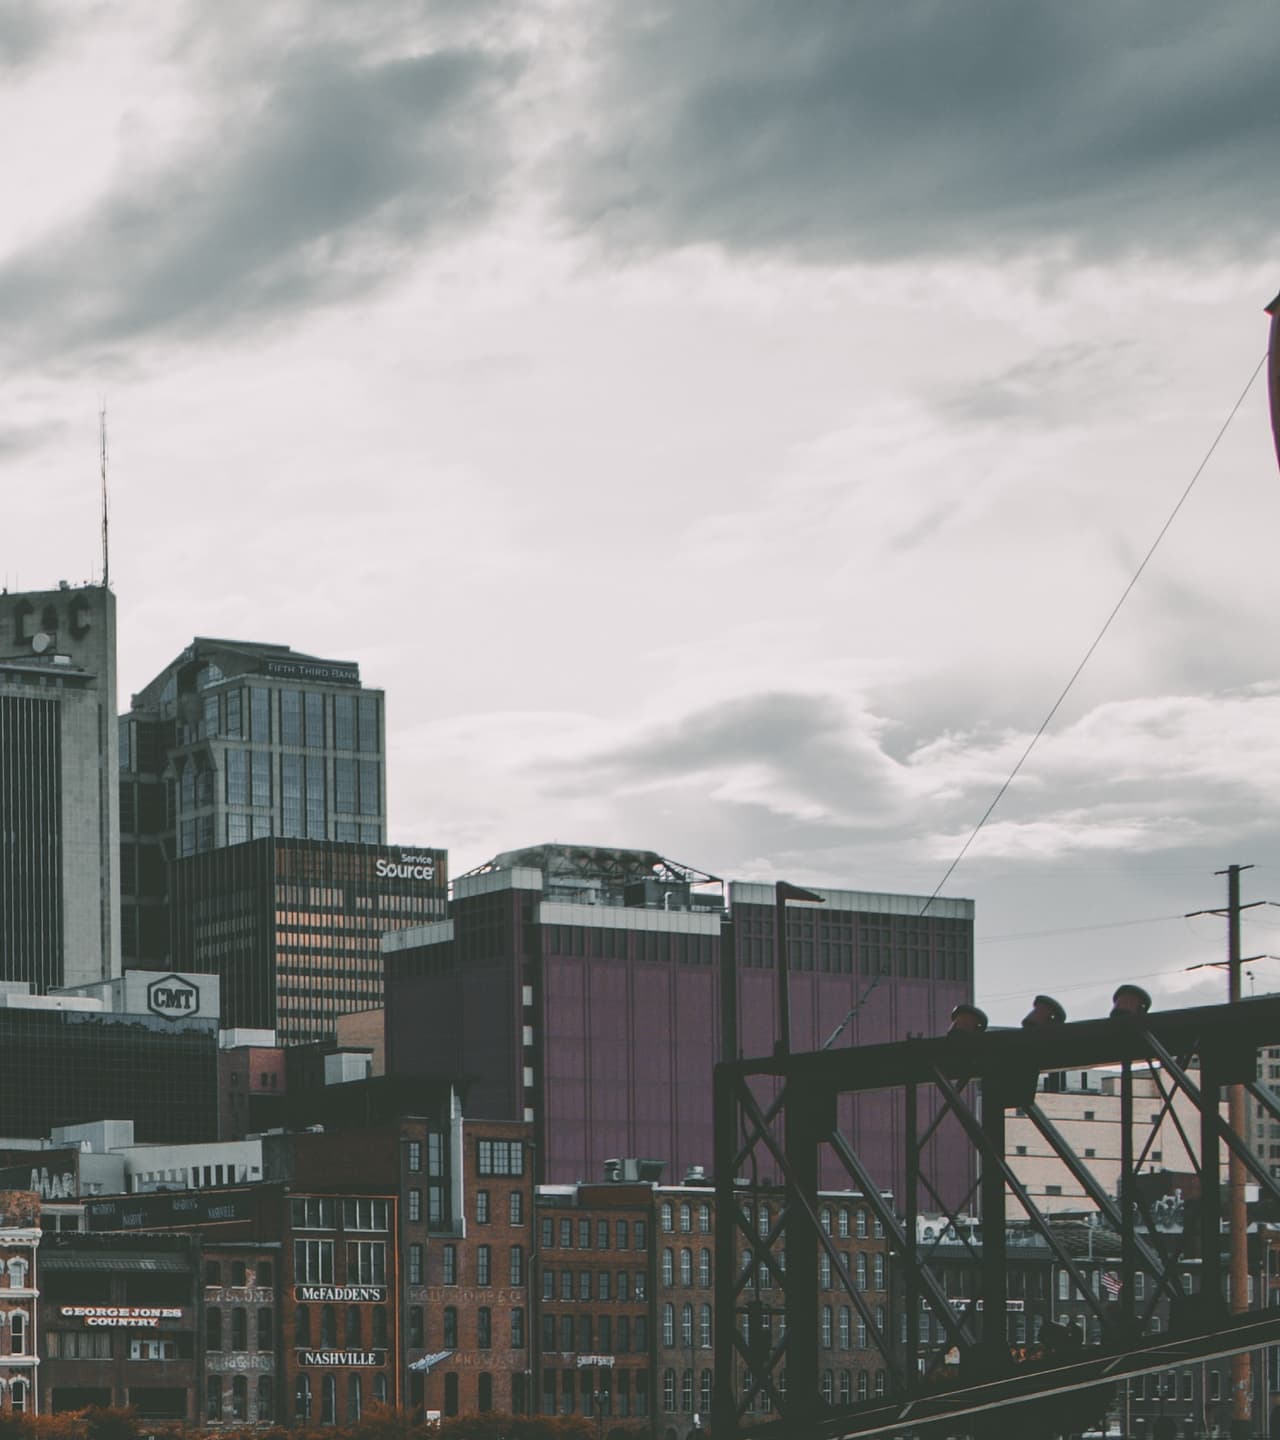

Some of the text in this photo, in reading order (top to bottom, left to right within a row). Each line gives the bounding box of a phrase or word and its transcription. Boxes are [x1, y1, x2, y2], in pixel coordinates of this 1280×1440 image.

[268, 662, 358, 680] FIFTH THIRD BANK
[400, 853, 432, 864] Service
[376, 859, 433, 881] Source
[153, 989, 193, 1010] CMT
[302, 1287, 381, 1301] McFADDEN'S
[60, 1306, 182, 1319] GEORGE JONES
[86, 1317, 160, 1327] COUNTRY
[304, 1352, 377, 1366] NASHVILLE
